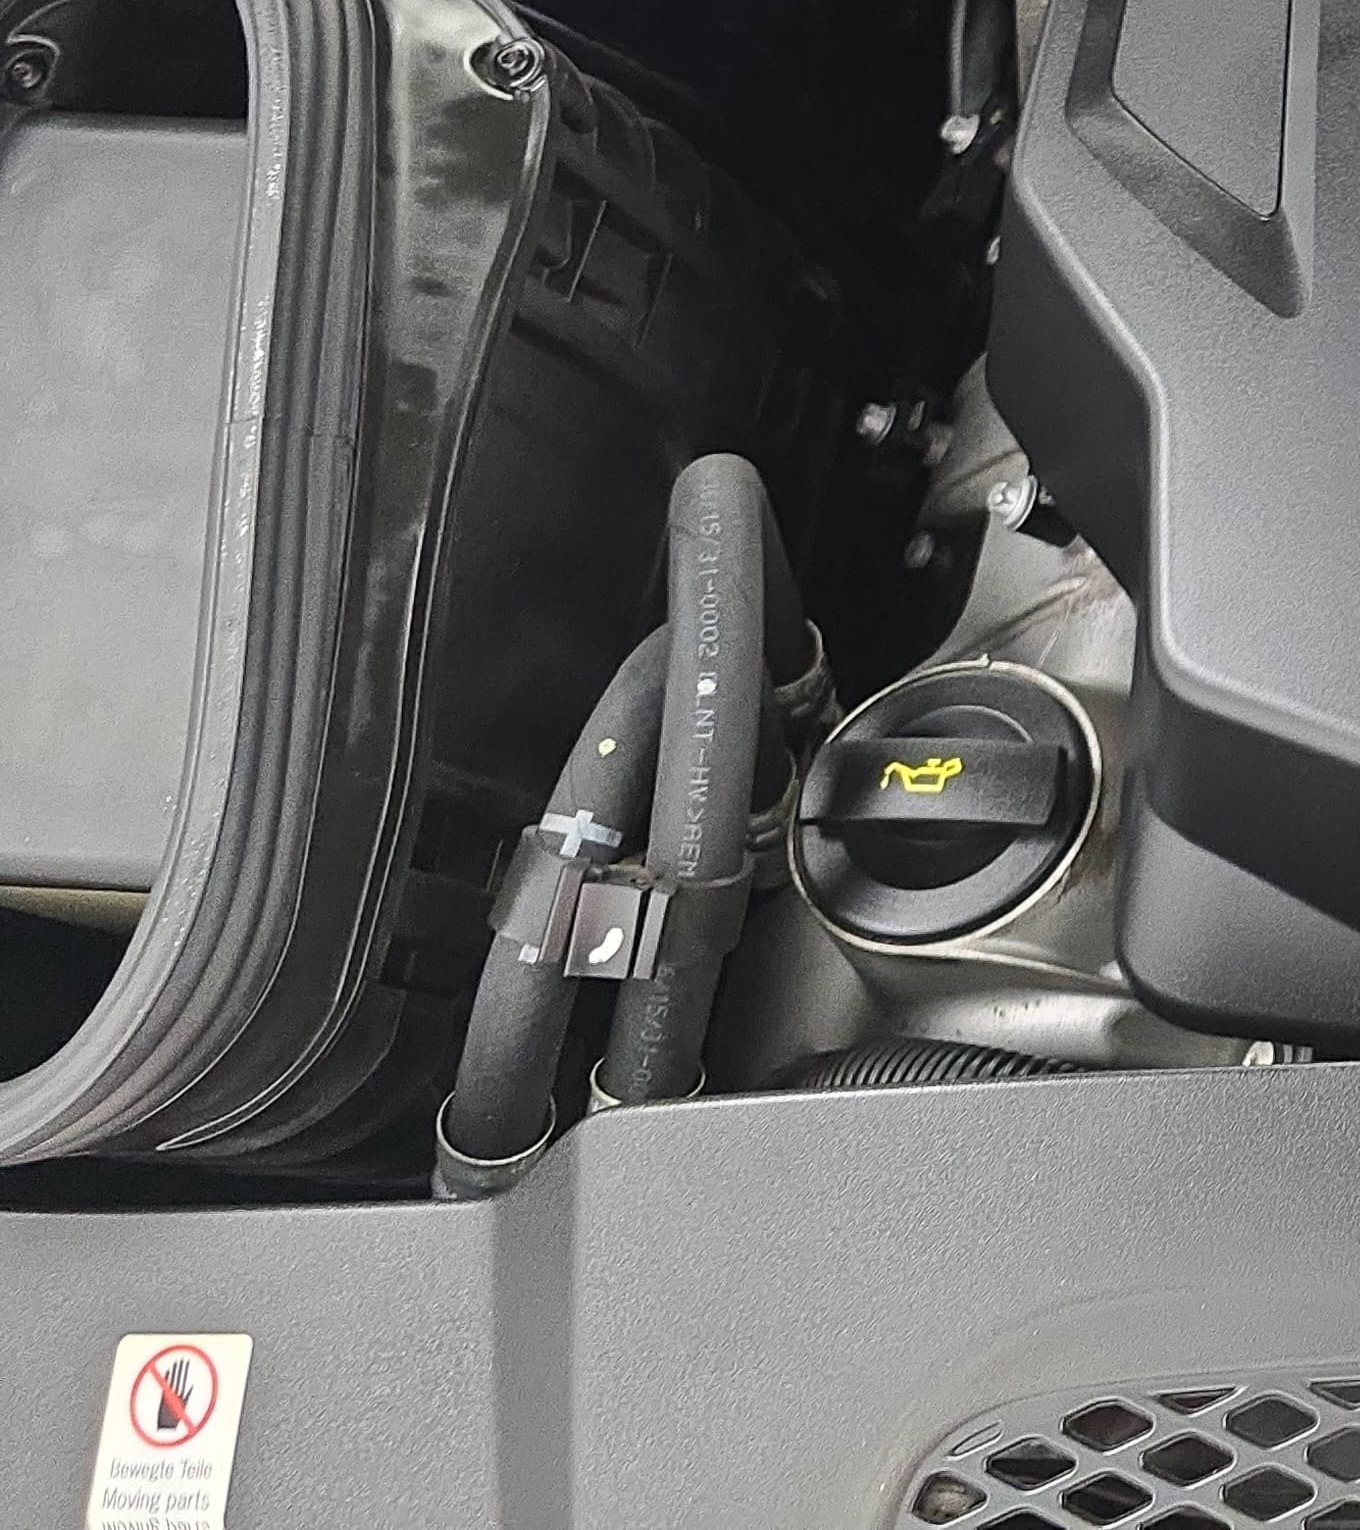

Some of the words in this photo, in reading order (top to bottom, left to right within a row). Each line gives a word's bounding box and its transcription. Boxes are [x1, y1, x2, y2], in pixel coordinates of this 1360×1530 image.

[109, 1458, 174, 1481] Bewegte
[180, 1458, 213, 1480] Teile
[101, 1488, 162, 1513] Moving
[166, 1489, 211, 1513] parts
